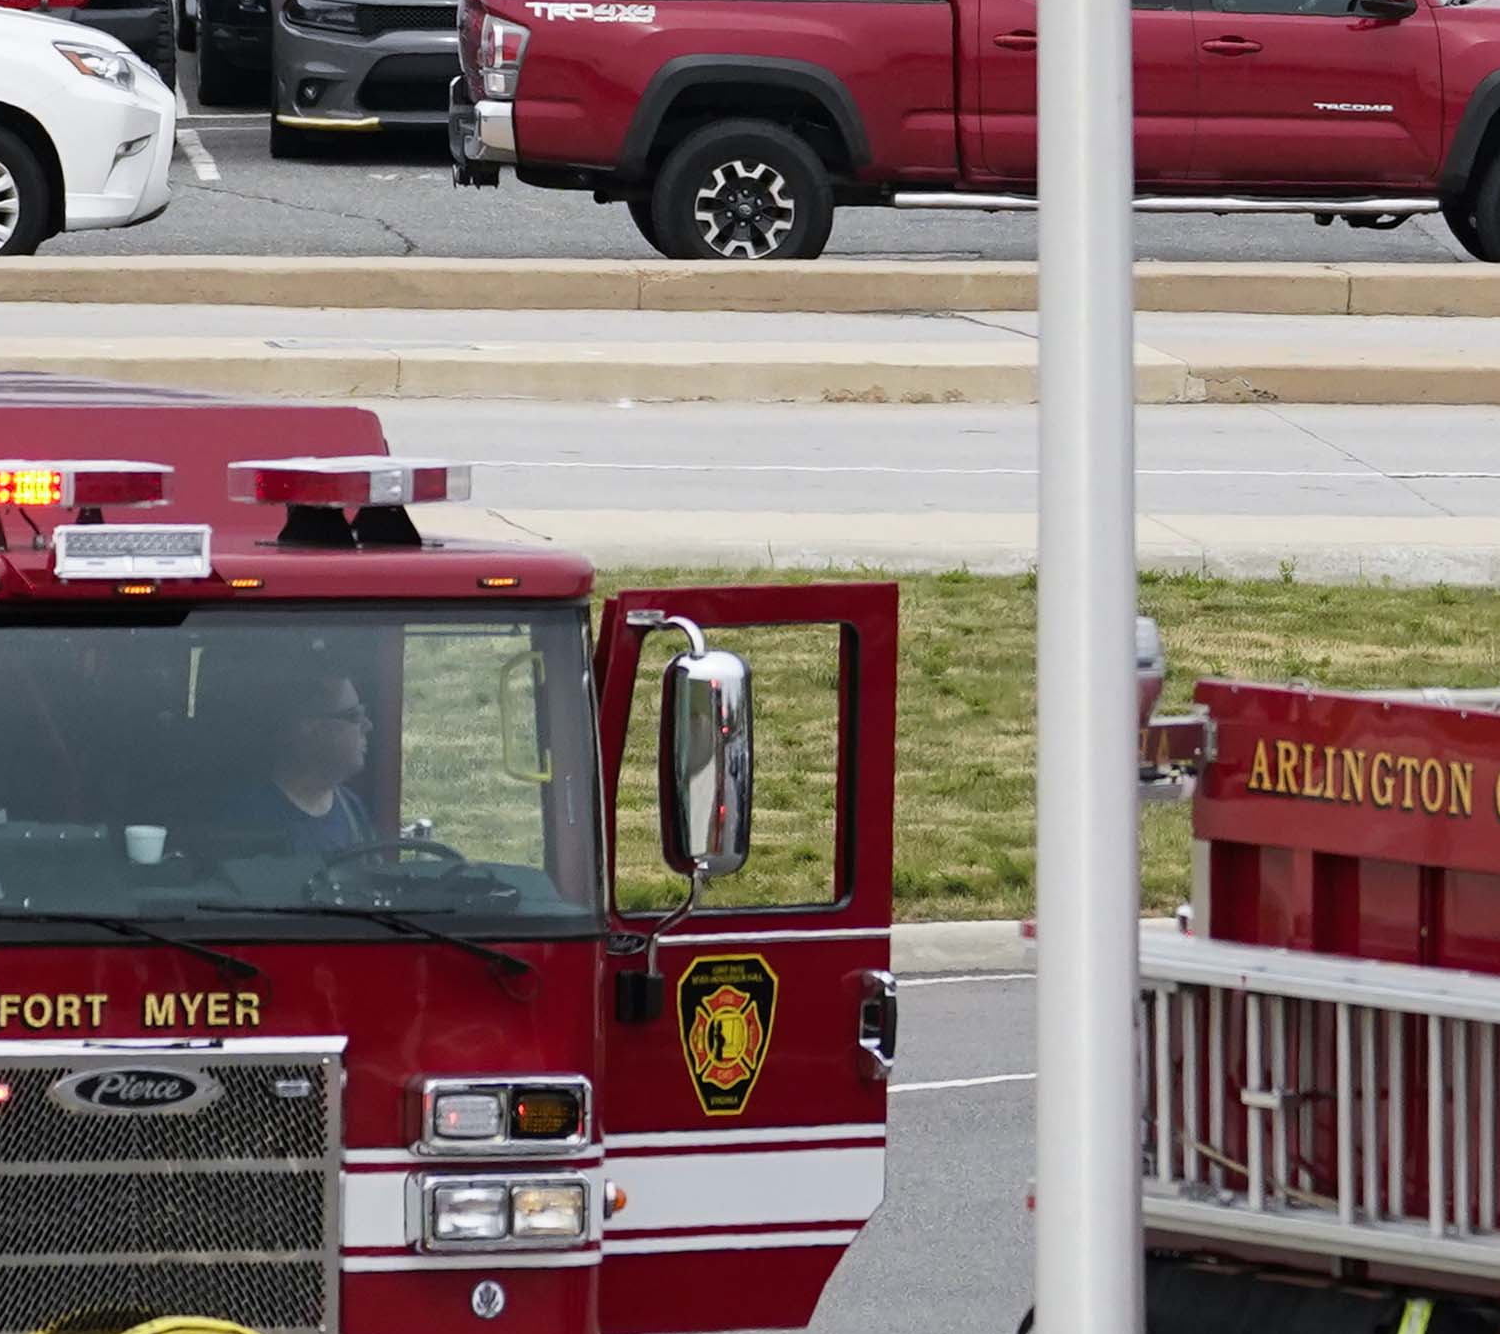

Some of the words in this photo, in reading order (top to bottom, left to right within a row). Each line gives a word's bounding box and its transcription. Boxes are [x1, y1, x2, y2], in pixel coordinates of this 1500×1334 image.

[525, 1, 592, 21] TRD
[1313, 102, 1394, 112] TACOMA
[1248, 739, 1475, 818] ARLINGTON
[143, 992, 261, 1027] MYER
[91, 1074, 182, 1104] Pierce
